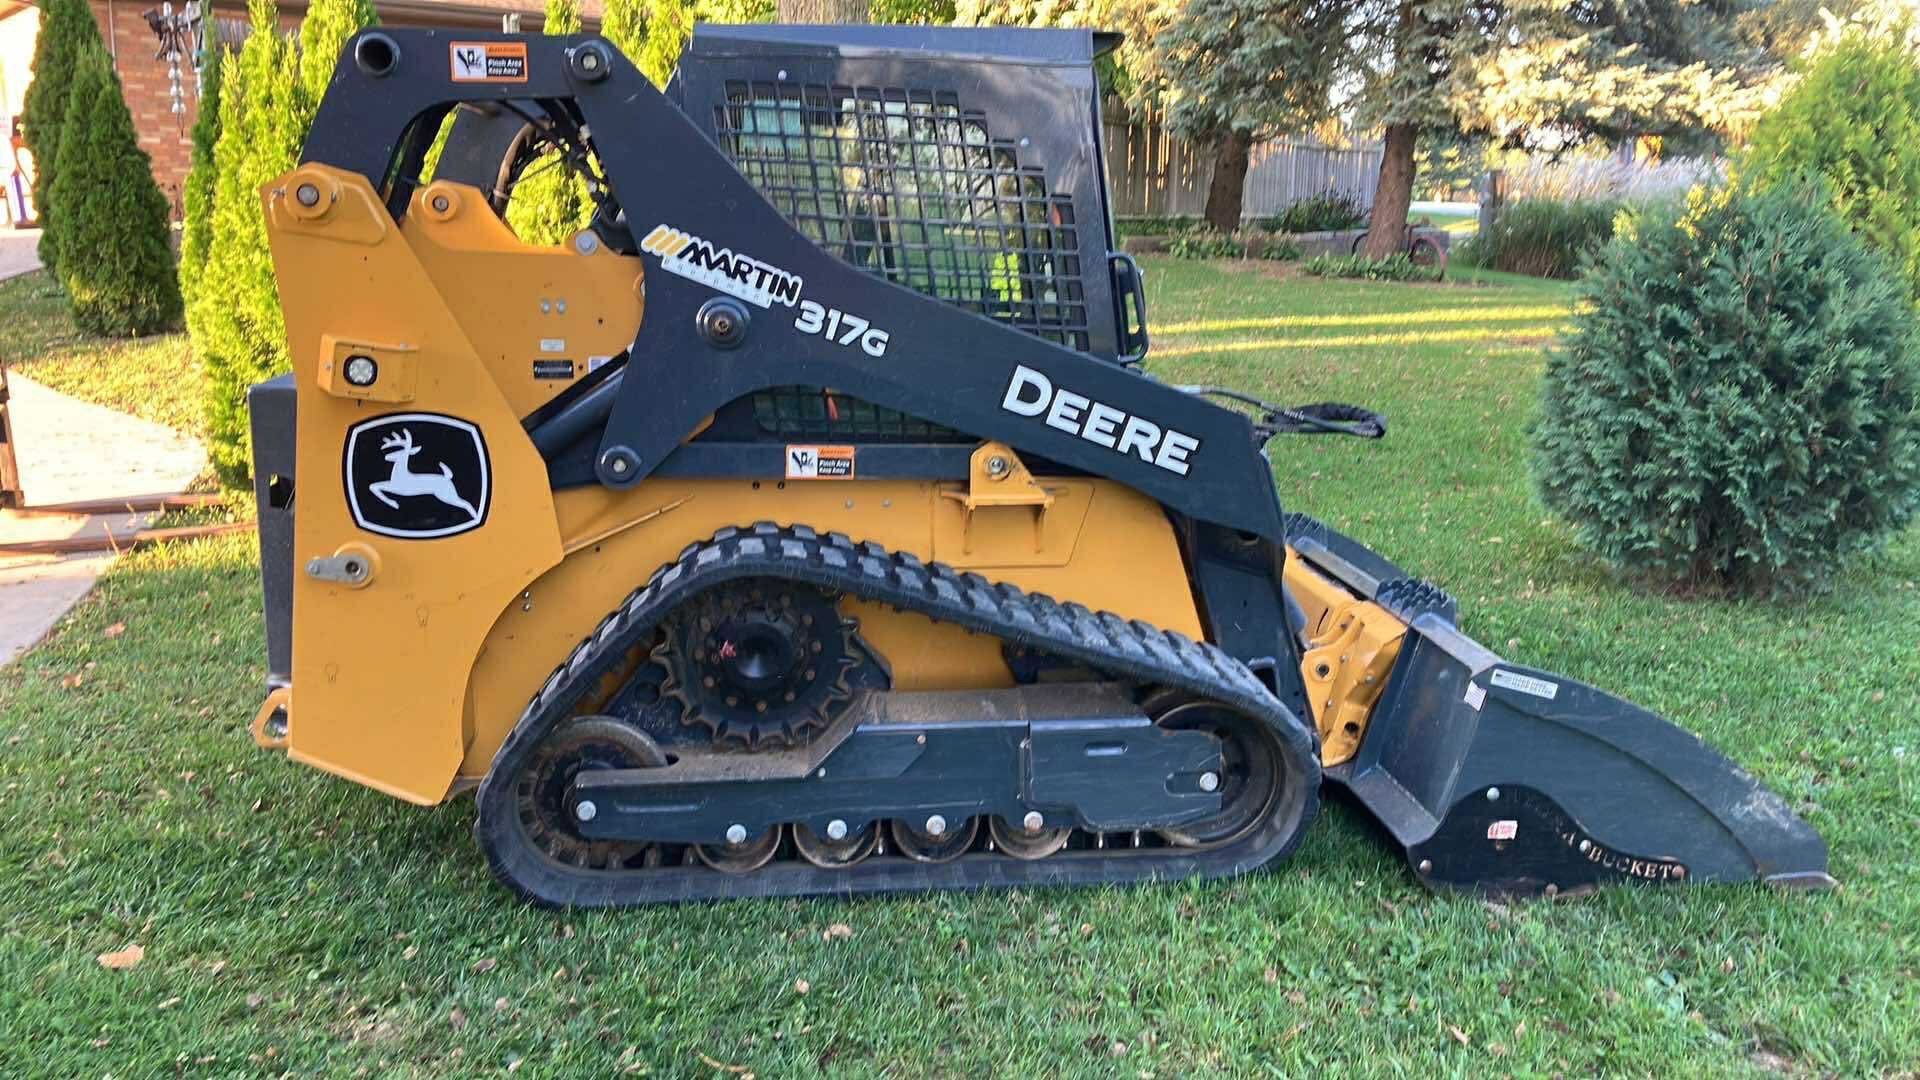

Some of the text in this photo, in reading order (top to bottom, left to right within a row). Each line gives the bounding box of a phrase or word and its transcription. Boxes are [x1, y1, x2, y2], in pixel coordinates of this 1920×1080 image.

[677, 241, 800, 302] MARTIN
[794, 300, 890, 358] 317G
[1002, 364, 1201, 476] DEERE
[1588, 845, 1673, 879] BUCKET
